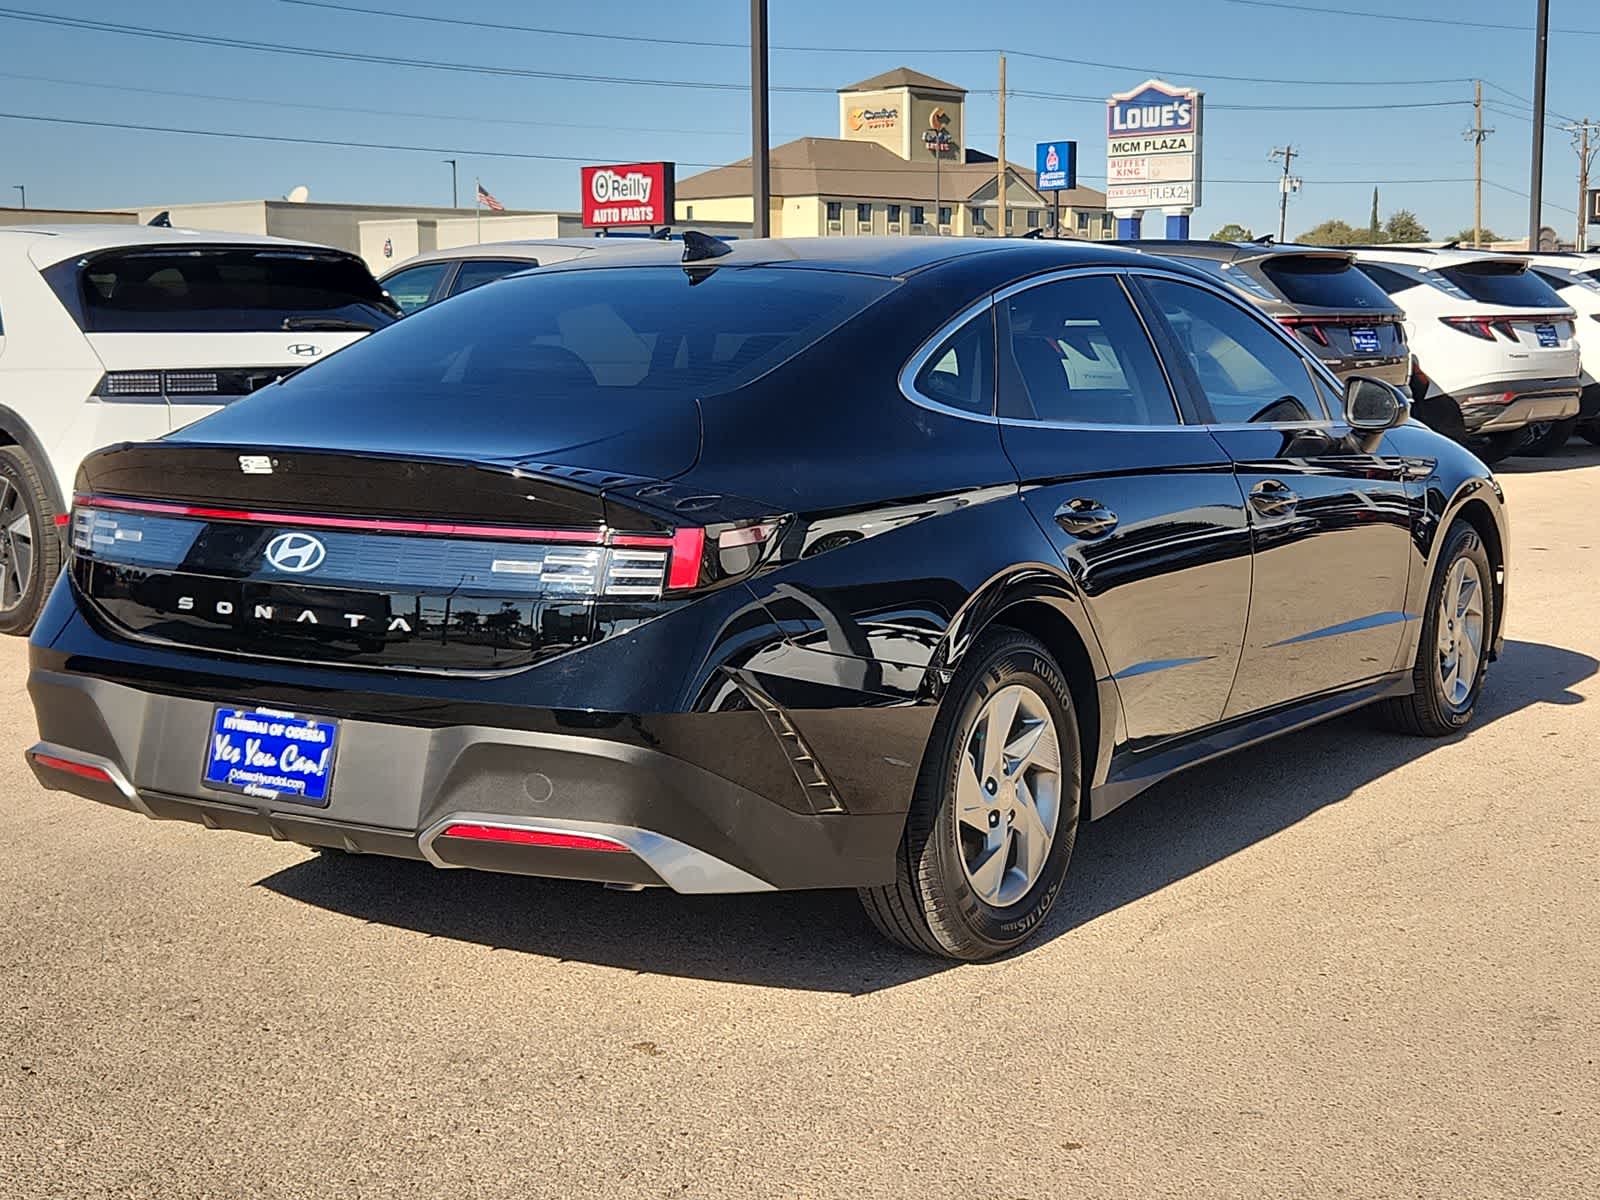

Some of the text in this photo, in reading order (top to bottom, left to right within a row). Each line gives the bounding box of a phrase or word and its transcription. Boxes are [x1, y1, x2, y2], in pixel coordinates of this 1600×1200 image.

[1113, 102, 1191, 130] LOWE'S
[1112, 138, 1187, 153] MCM PLAZA
[1111, 159, 1145, 169] BUFFET
[1116, 168, 1141, 177] KING
[594, 172, 650, 201] O'Reilly
[593, 206, 654, 223] AUTO PARTS
[178, 597, 412, 633] SONATA
[1032, 657, 1071, 711] KUMHO
[269, 723, 286, 737] OF
[214, 733, 330, 777] Yes You Can!
